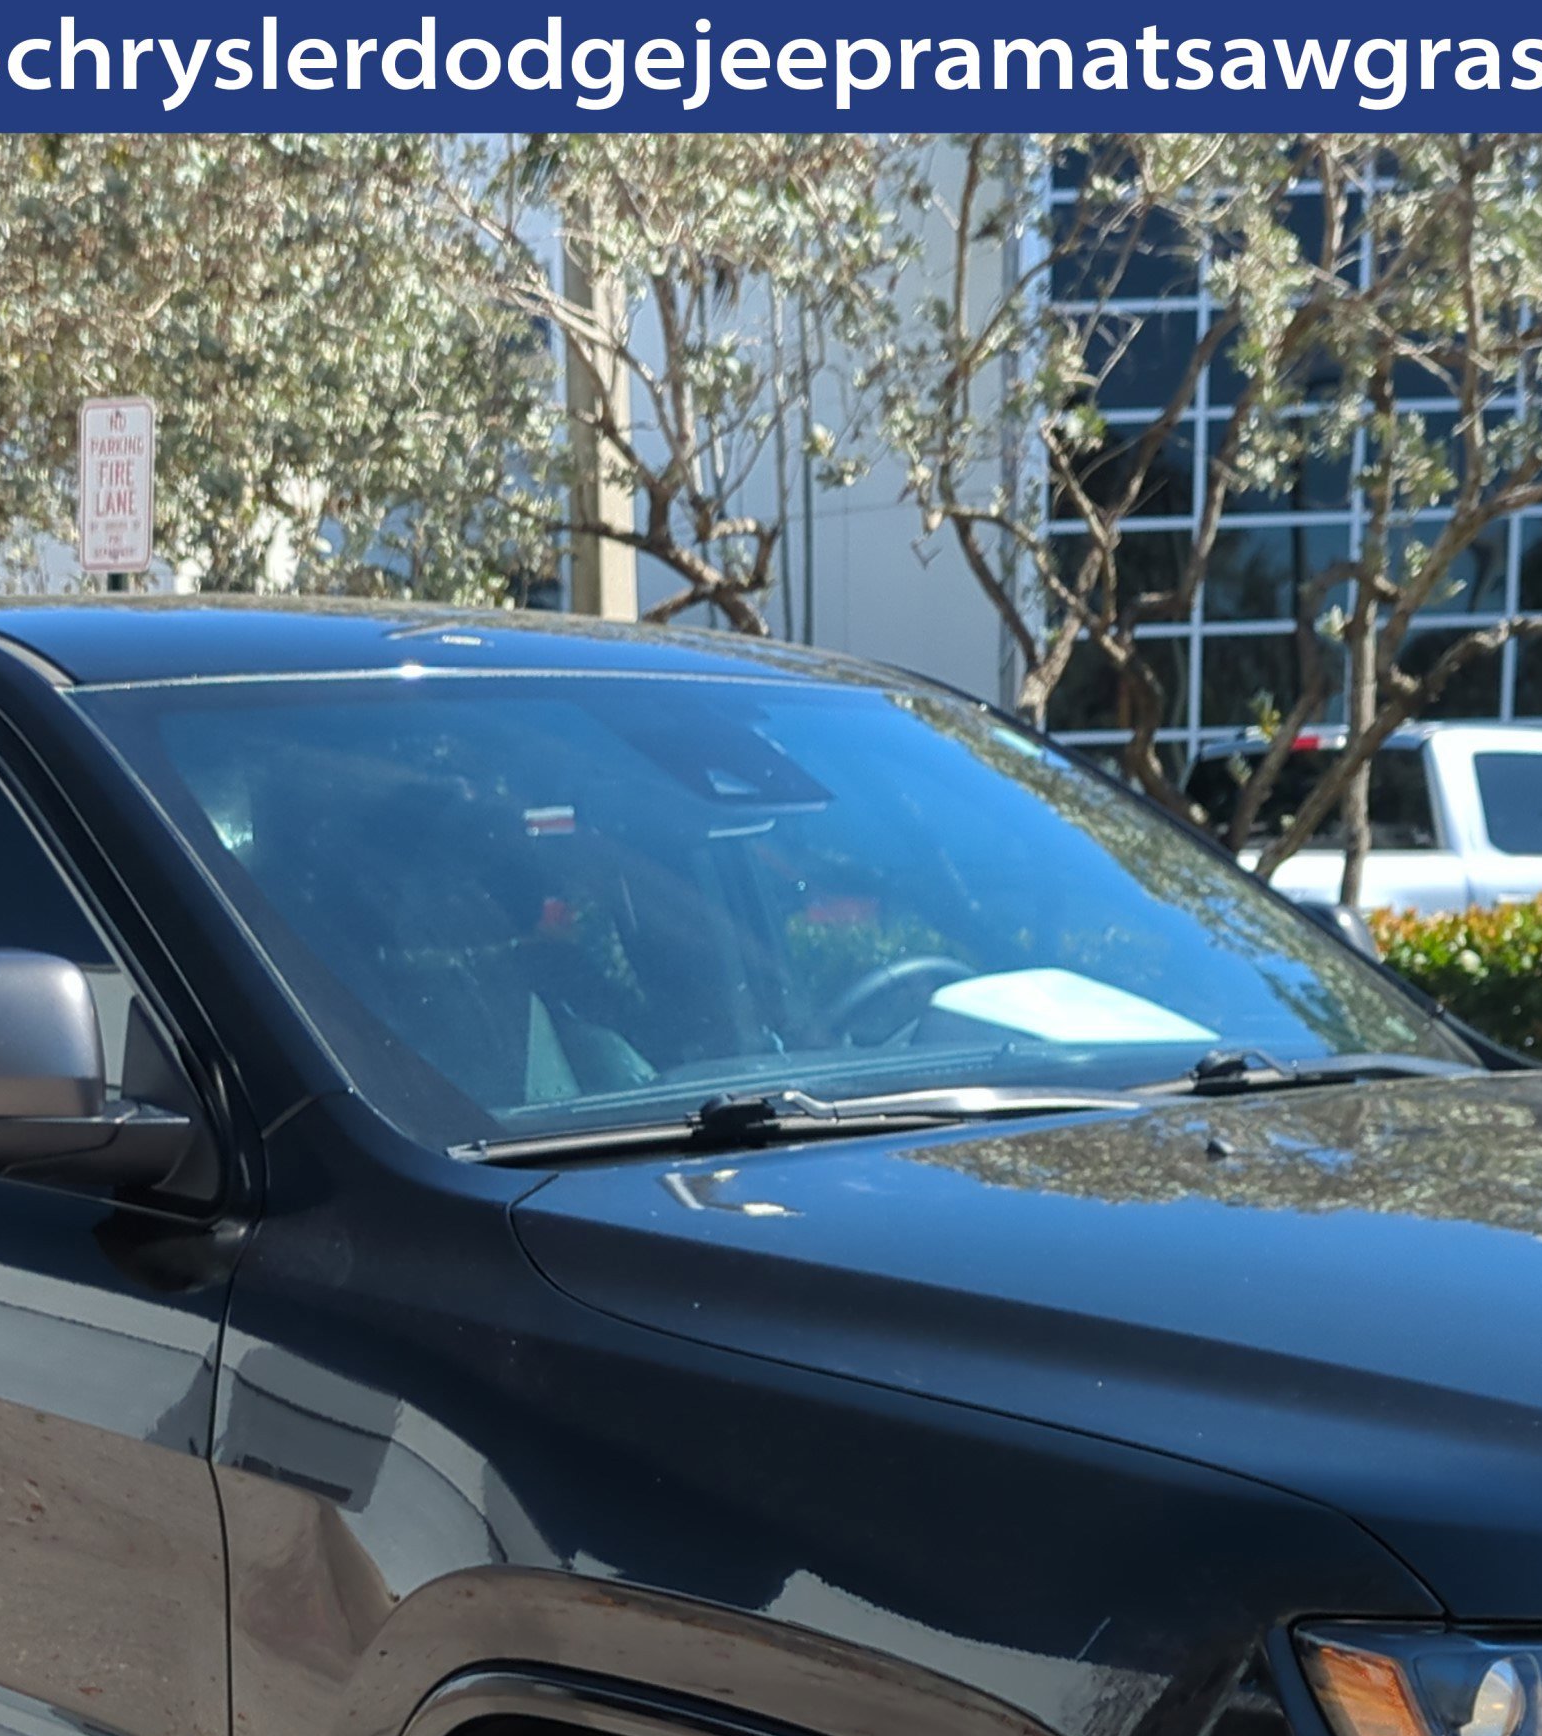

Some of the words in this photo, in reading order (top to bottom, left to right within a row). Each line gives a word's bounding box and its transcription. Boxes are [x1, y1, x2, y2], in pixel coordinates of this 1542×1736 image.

[90, 435, 144, 456] PARKING
[99, 460, 135, 486] FIRE
[96, 491, 136, 517] LANE
